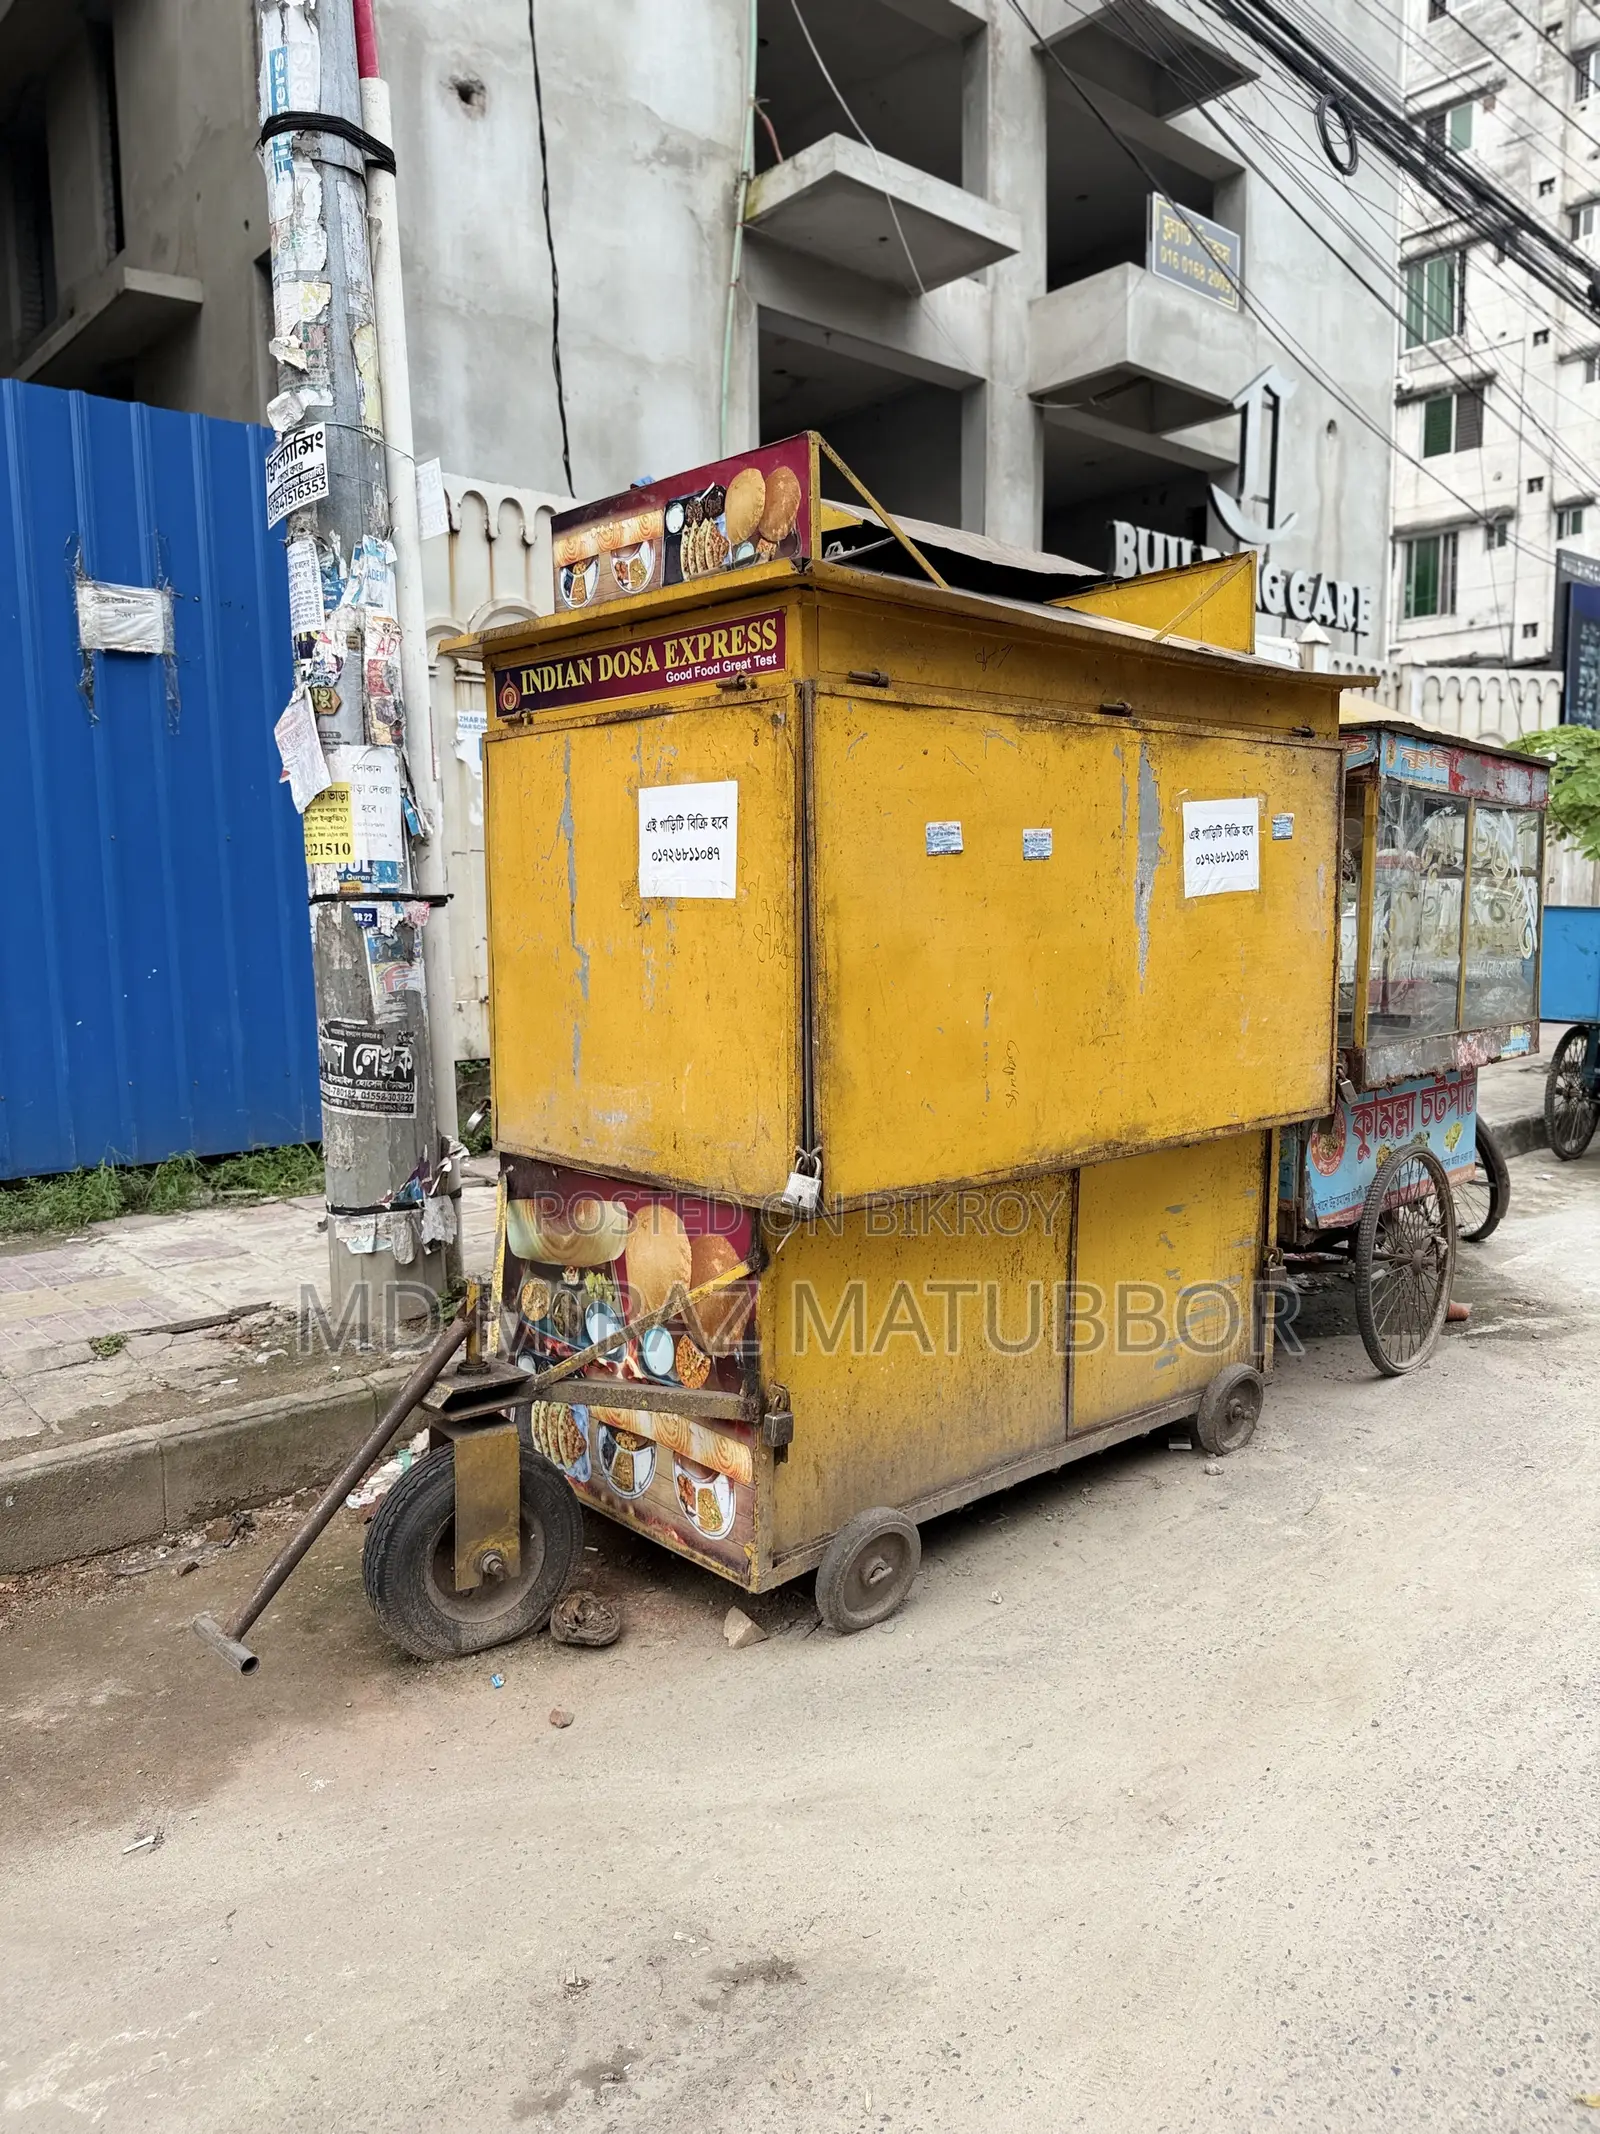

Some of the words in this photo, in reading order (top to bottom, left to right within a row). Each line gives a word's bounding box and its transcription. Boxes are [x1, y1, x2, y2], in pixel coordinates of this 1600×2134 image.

[1160, 246, 1179, 270] 016
[269, 476, 327, 520] 01841516353
[520, 657, 593, 696] INDIAN
[597, 645, 660, 682] DOSA
[663, 618, 778, 669] EXPRESS
[666, 669, 693, 684] Good
[694, 664, 720, 680] Food
[722, 658, 752, 674] Great
[753, 653, 777, 668] Test
[646, 818, 657, 833] এই
[659, 814, 685, 834] গাড়িটি
[687, 813, 708, 831] বিক্রি
[711, 816, 728, 830] হবে
[1189, 828, 1200, 840] এই
[1202, 825, 1223, 841] গাড়িটি
[1224, 823, 1240, 838] বিক্রি
[1242, 825, 1254, 836] হবে
[651, 846, 720, 863] ০১৭২৬৮১১০৪৭
[363, 913, 372, 921] 22
